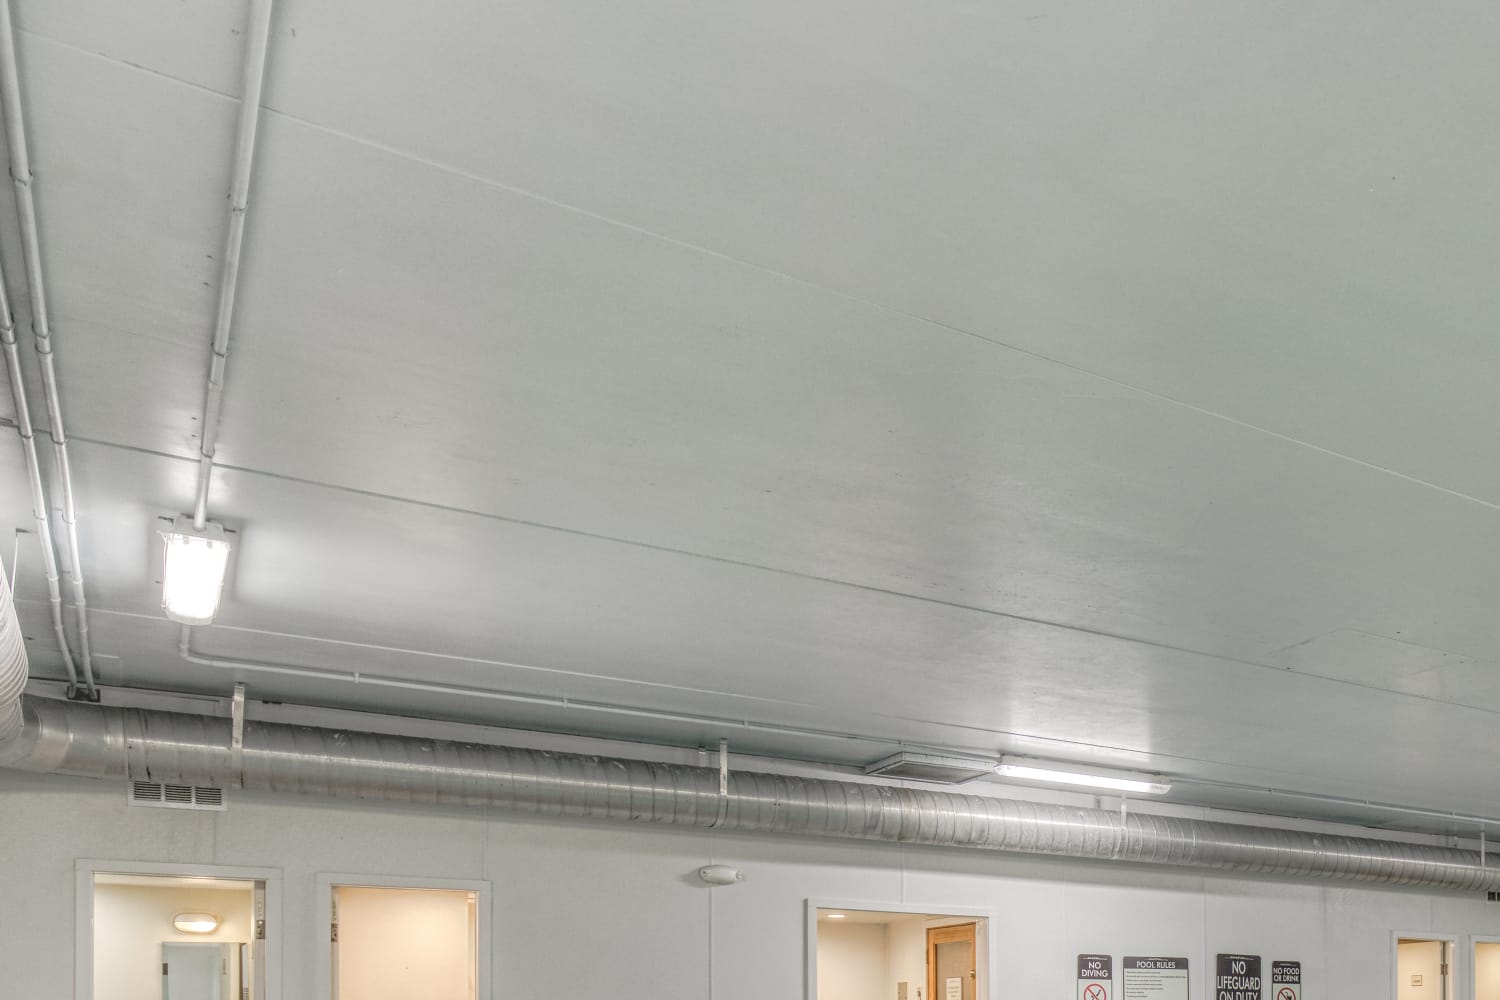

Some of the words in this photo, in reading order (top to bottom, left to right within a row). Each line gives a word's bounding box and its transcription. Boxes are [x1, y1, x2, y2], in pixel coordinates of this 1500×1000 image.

[1088, 961, 1102, 970] NO
[1136, 961, 1156, 969] POOL
[1156, 961, 1176, 969] RULES
[1231, 960, 1246, 975] NO
[1081, 970, 1109, 978] DIVING
[1273, 967, 1283, 975] NO
[1283, 967, 1300, 975] FOOD
[1273, 974, 1281, 982] OR
[1282, 974, 1300, 982] DRINK
[1217, 975, 1261, 990] LIFEGUARD
